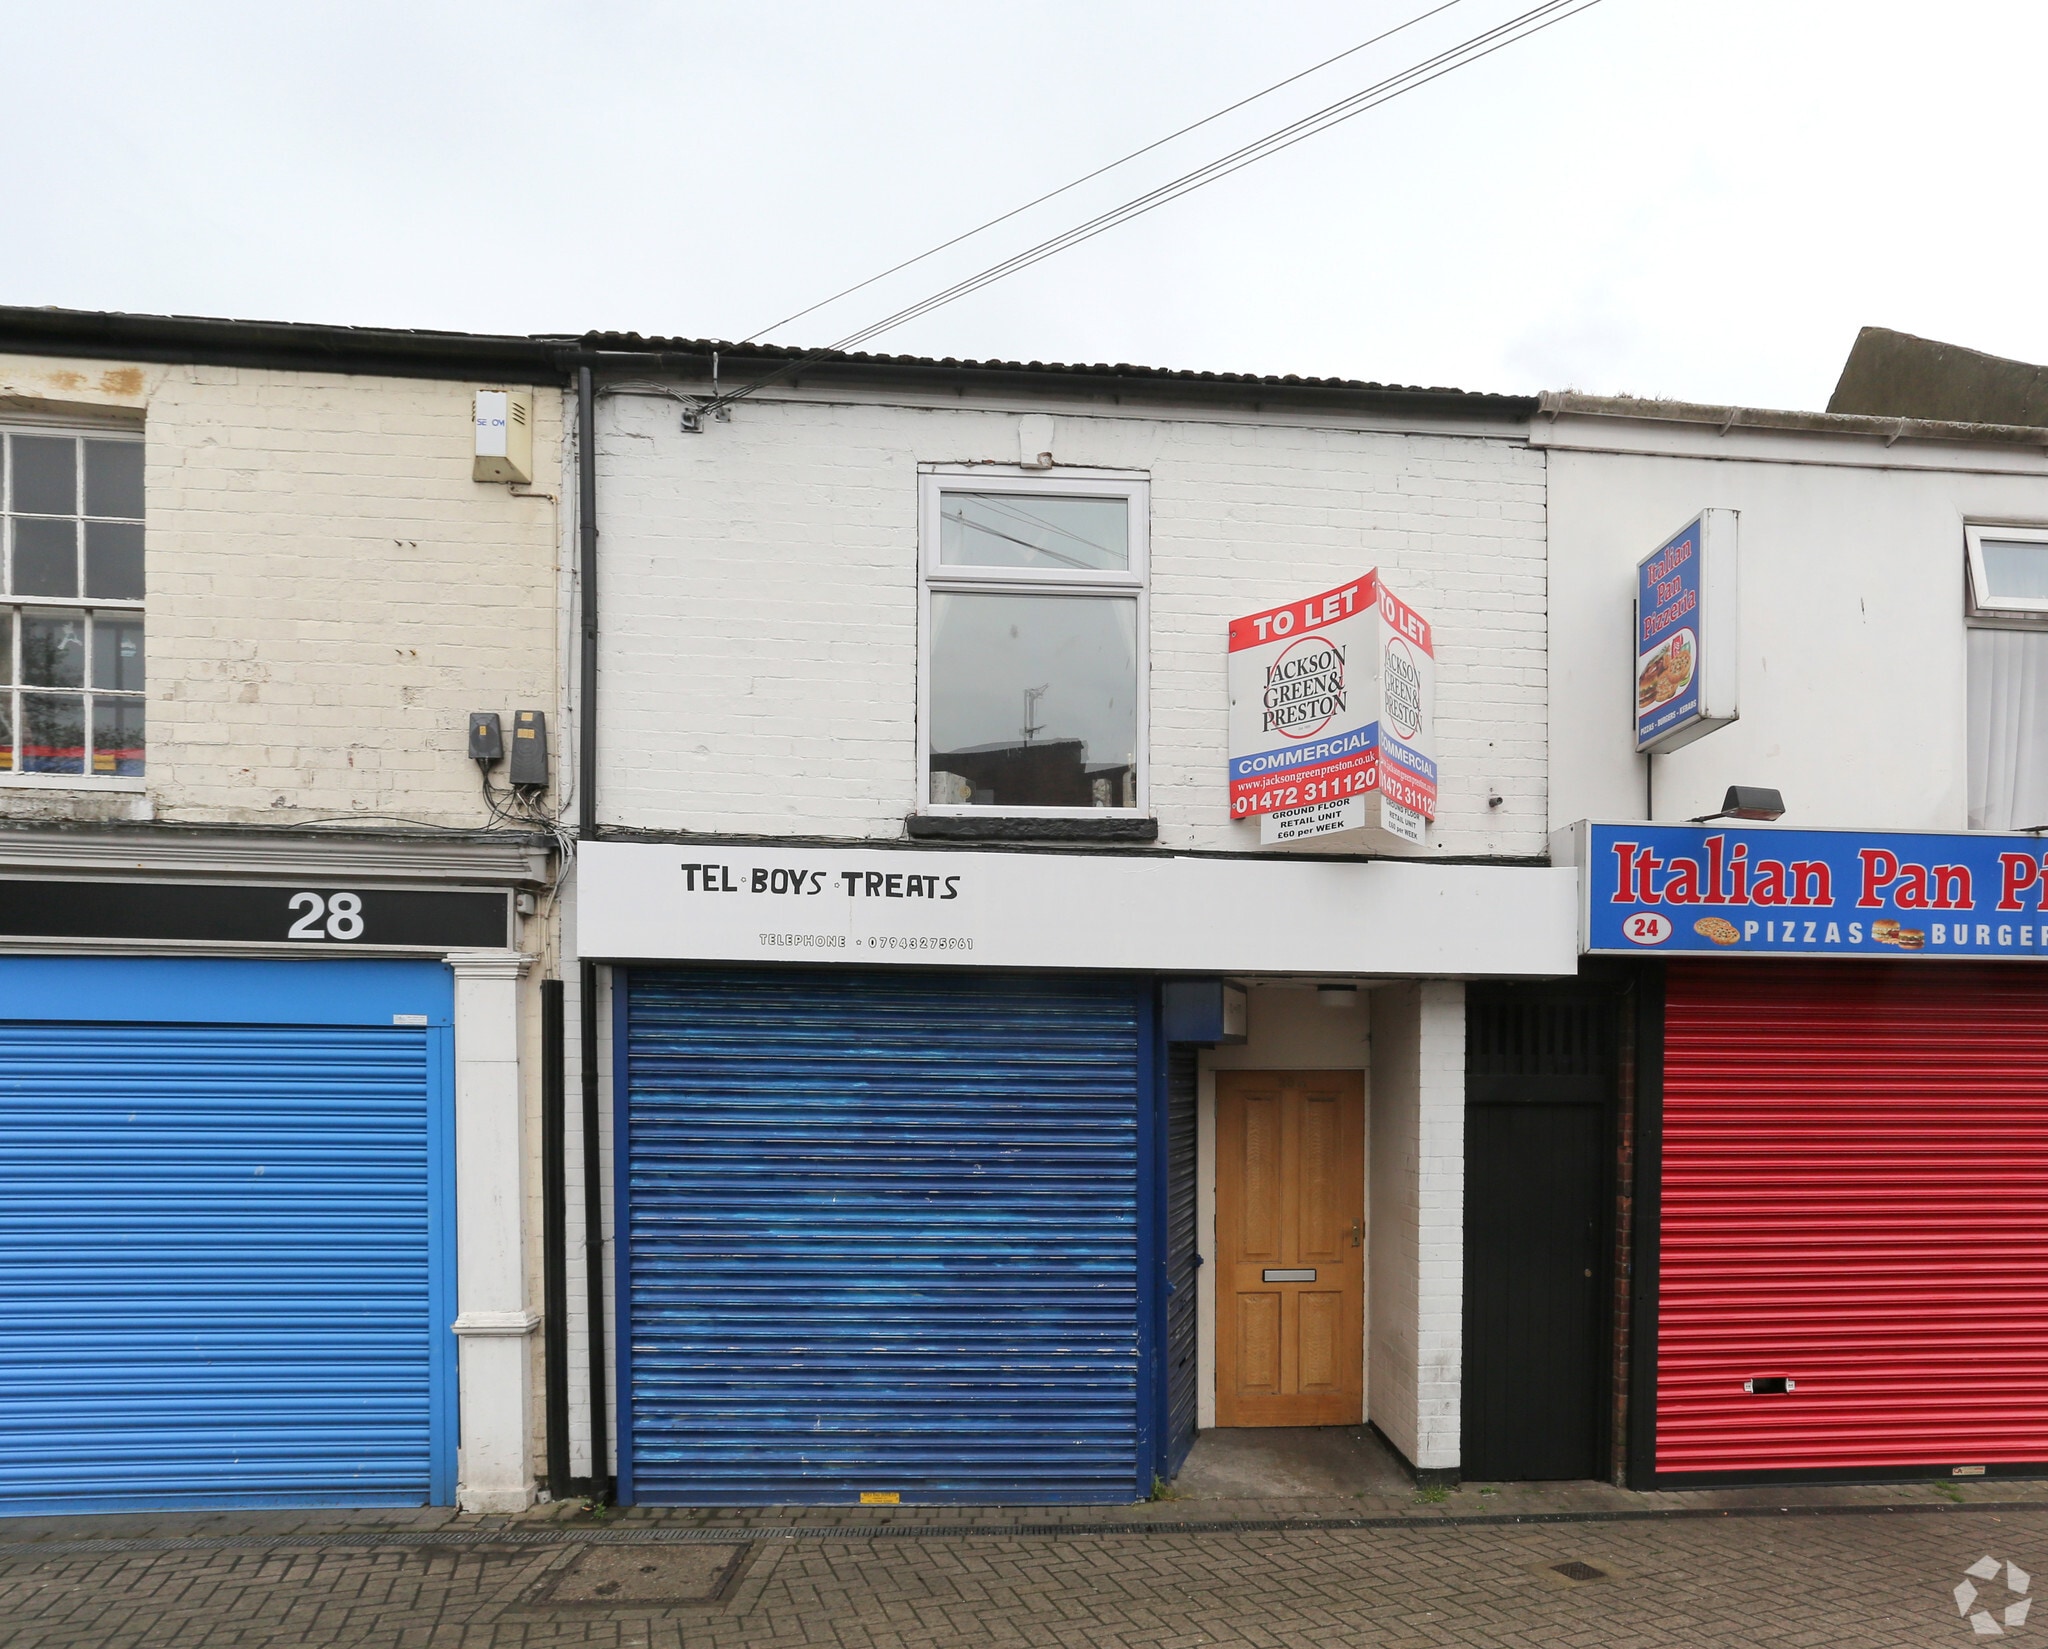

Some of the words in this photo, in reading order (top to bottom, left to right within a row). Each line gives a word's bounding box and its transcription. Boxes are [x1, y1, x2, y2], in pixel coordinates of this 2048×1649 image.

[476, 418, 505, 428] SEOM
[1646, 539, 1692, 589] Italian
[1656, 574, 1682, 608] Pan
[1253, 610, 1295, 641] TO
[1304, 585, 1358, 627] LET
[1399, 606, 1425, 646] LET
[1643, 588, 1697, 641] Pizzeria
[1263, 644, 1347, 689] JACKSON
[1262, 691, 1347, 732] PRESTON
[1384, 690, 1422, 735] PRESTON
[1238, 732, 1370, 774] COMMERCIAL
[1238, 751, 1376, 791] www.jacksongreenpreston.co.uk
[1236, 787, 1298, 813] 01472
[1304, 767, 1376, 801] 311120
[1272, 806, 1315, 820] GROUND
[1317, 798, 1350, 812] FLOOR
[1277, 830, 1295, 839] £60
[1297, 828, 1313, 837] per
[1316, 821, 1344, 833] WEEK
[1280, 816, 1315, 828] RETAIL
[1318, 811, 1342, 822] UNIT
[681, 863, 738, 892] TEL
[751, 867, 827, 895] BOYS
[841, 871, 961, 900] TREATS
[1610, 833, 1836, 908] Italian
[1855, 847, 1976, 911] Pan
[287, 892, 364, 940] 28
[1634, 918, 1658, 937] 24
[1744, 920, 1863, 944] PIZZAS
[759, 933, 846, 948] TELEPHONE
[867, 936, 974, 950] 07943275961
